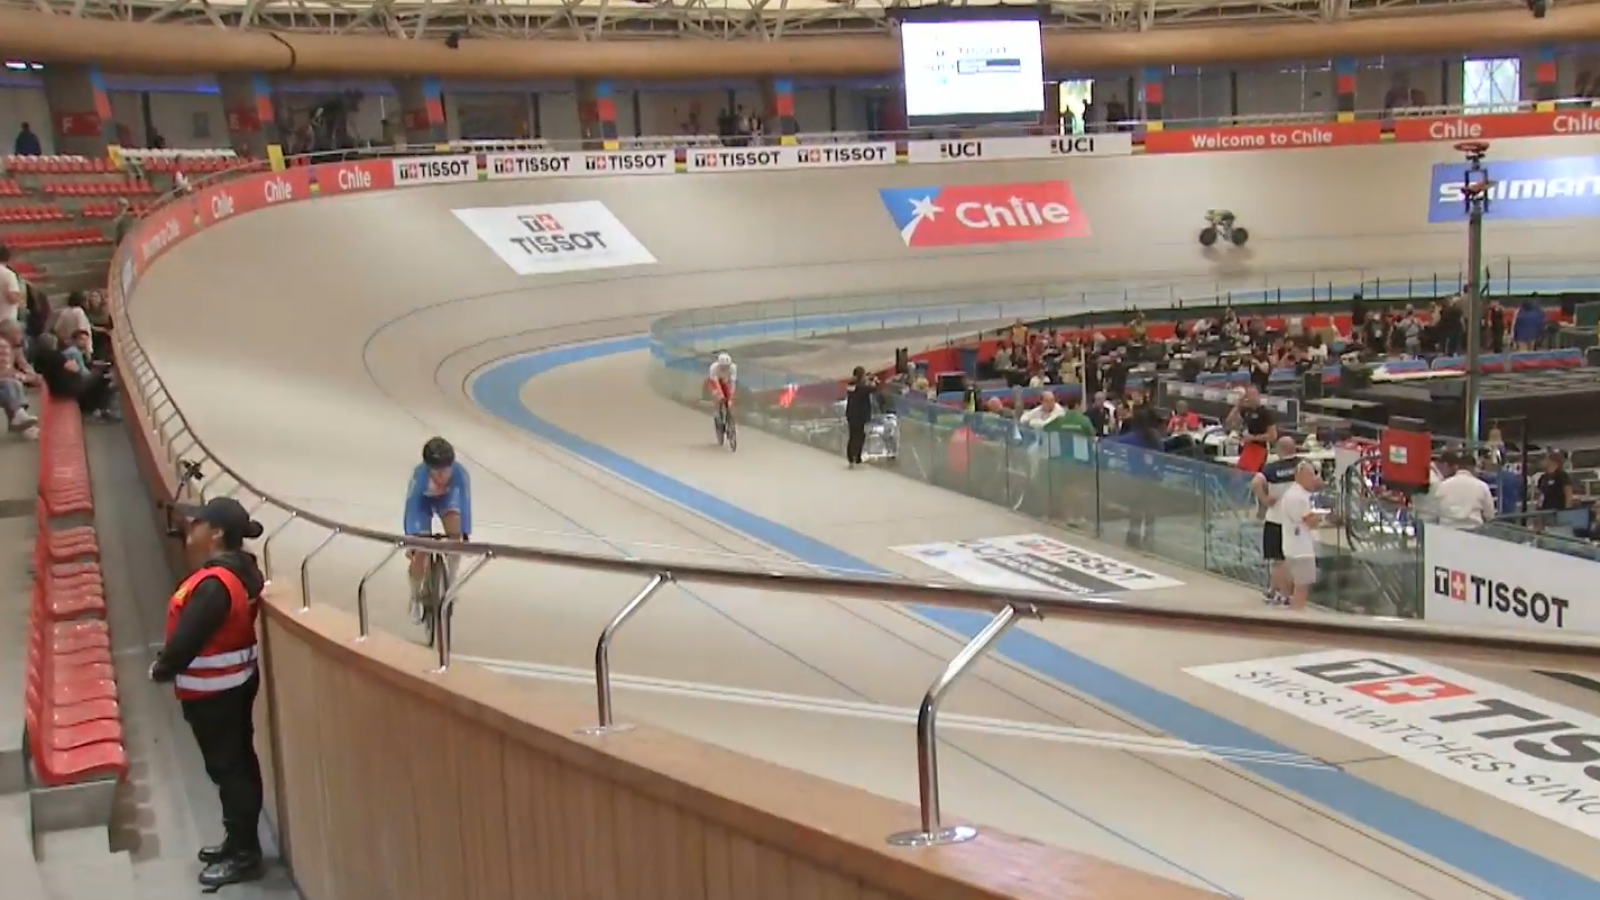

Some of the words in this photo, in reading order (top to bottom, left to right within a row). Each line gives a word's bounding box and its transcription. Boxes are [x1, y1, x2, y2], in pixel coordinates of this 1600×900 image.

[1192, 133, 1265, 149] Welcome
[1270, 131, 1287, 145] to
[1291, 127, 1333, 144] Chile
[1430, 119, 1482, 138] Chile
[824, 146, 887, 162] TISSOT
[948, 142, 982, 157] UCI
[1058, 137, 1094, 153] UCI
[516, 156, 570, 172] TISSOT
[608, 154, 667, 170] TISSOT
[719, 151, 781, 167] TISSOT
[338, 166, 371, 190] Chile
[420, 160, 469, 178] TISSOT
[955, 195, 1070, 229] Chile
[509, 231, 608, 256] TISSOT
[1470, 575, 1569, 628] TISSOT
[1235, 670, 1343, 707] SWISS
[1334, 705, 1516, 773] WATCHES
[1429, 698, 1600, 783] TIS
